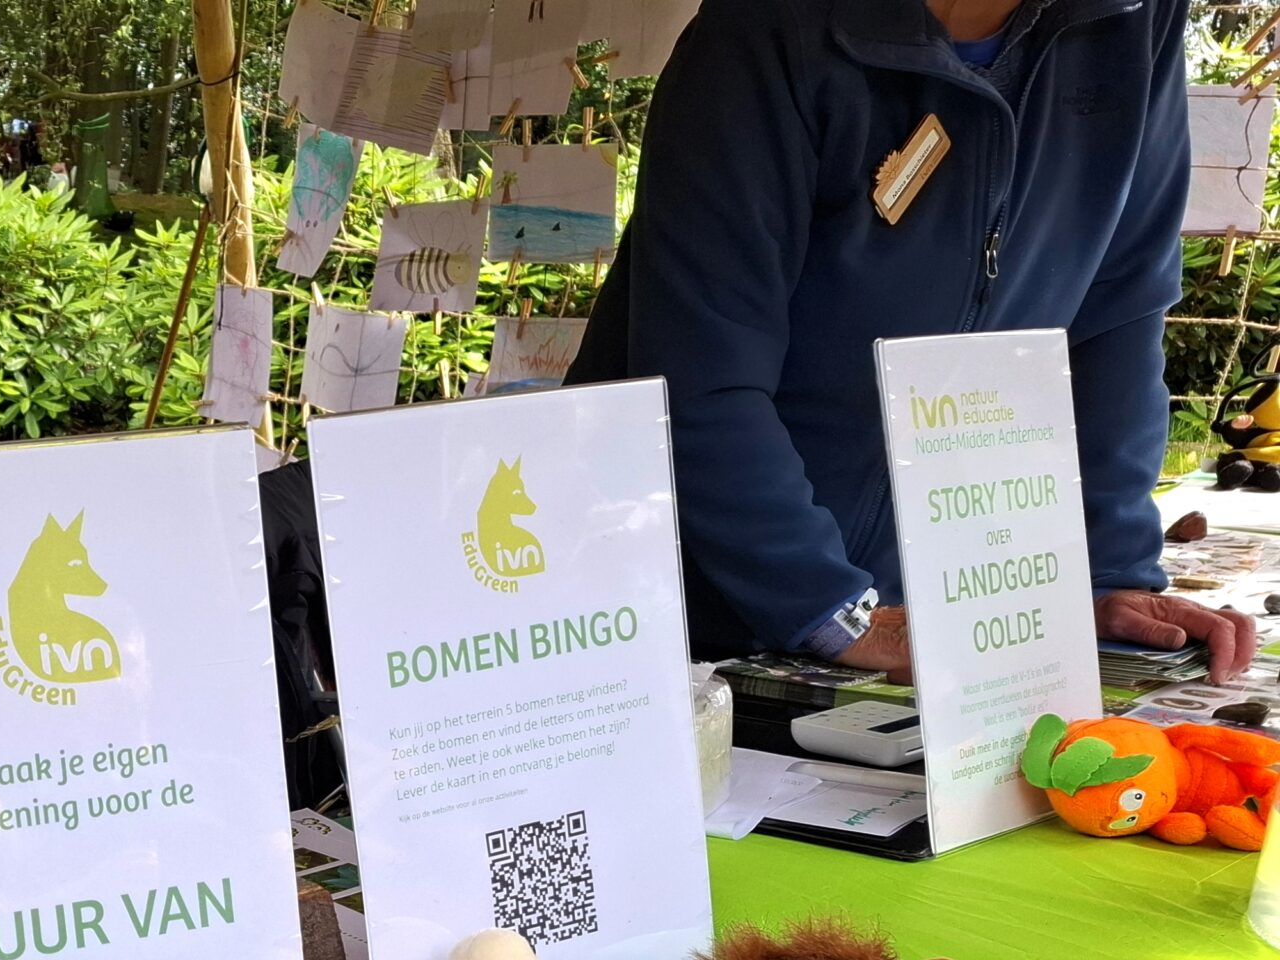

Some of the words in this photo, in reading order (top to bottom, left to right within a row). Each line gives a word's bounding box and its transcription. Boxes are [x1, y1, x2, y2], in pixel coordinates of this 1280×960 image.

[909, 385, 959, 430] ivn
[960, 388, 999, 406] natuur
[963, 406, 1015, 425] educatie
[915, 430, 996, 455] Noord-Midden
[998, 423, 1055, 445] Achterhoek
[927, 480, 998, 524] STORY
[1001, 473, 1058, 512] TOUR
[495, 541, 541, 572] ivn
[986, 528, 1013, 547] OVER
[460, 531, 519, 593] EduGreen
[942, 551, 1059, 605] LANDGOED
[37, 632, 114, 675] ivn
[385, 627, 520, 689] BOMEN
[529, 605, 639, 661] BINGO
[973, 607, 1045, 654] OOLDE
[389, 727, 413, 741] Kun
[413, 723, 425, 739] jij
[426, 720, 442, 736] op
[444, 714, 464, 730] het
[466, 706, 504, 725] terrein
[505, 703, 513, 716] 5
[515, 697, 554, 714] bomen
[556, 688, 585, 705] terug
[586, 679, 628, 699] vinden?
[391, 745, 420, 762] Zoek
[421, 741, 436, 755] de
[438, 732, 480, 751] bomen
[482, 730, 497, 742] en
[499, 724, 521, 738] vind
[524, 718, 538, 732] de
[540, 710, 575, 728] letters
[577, 706, 595, 720] om
[597, 702, 616, 717] het
[617, 693, 650, 712] woord
[57, 750, 85, 787] je
[93, 741, 170, 779] eigen
[393, 769, 406, 781] te
[408, 761, 444, 777] raden.
[446, 753, 477, 769] Weet
[478, 750, 490, 766] je
[492, 745, 513, 760] ook
[515, 738, 546, 755] welke
[548, 729, 587, 747] bomen
[589, 723, 607, 738] het
[609, 717, 631, 736] zijn?
[396, 784, 428, 801] Lever
[430, 779, 445, 793] de
[447, 772, 477, 790] kaart
[478, 769, 490, 783] in
[492, 766, 507, 780] en
[509, 755, 553, 776] ontvang
[553, 754, 565, 769] je
[567, 741, 616, 763] beloning!
[88, 788, 153, 818] voor
[160, 779, 196, 806] de
[119, 877, 237, 939] VAN
